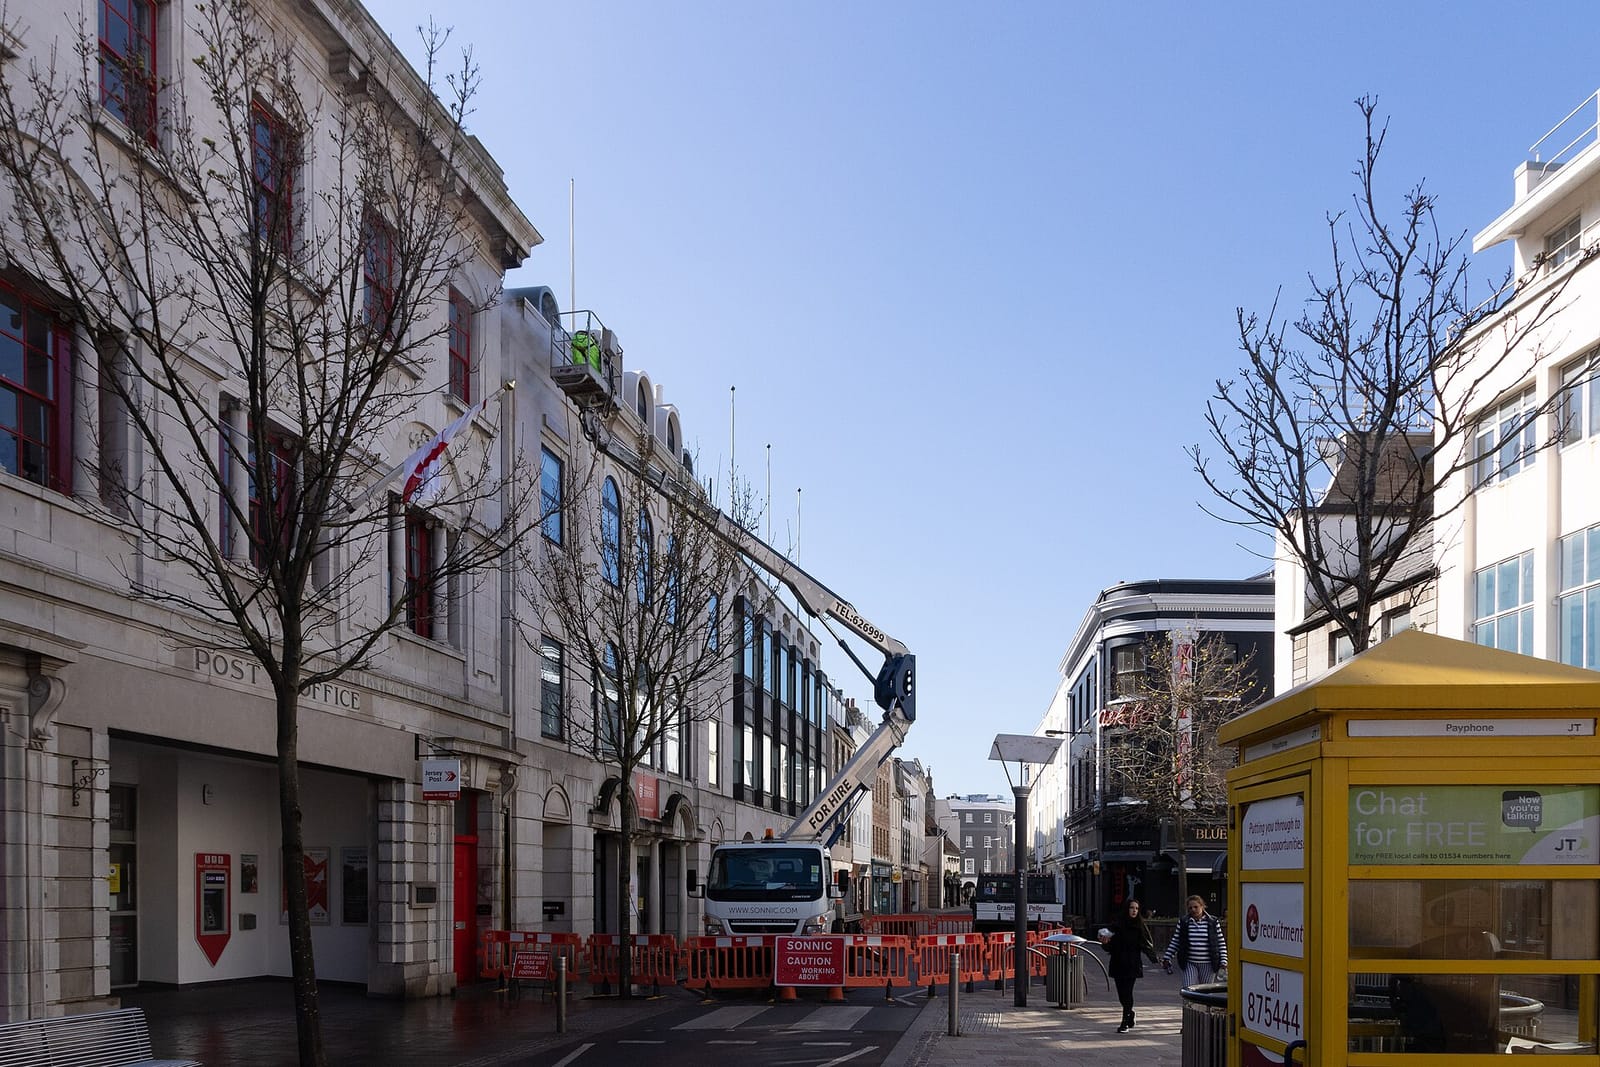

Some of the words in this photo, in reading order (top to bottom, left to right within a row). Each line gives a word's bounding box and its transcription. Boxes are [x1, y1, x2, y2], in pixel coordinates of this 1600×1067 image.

[835, 601, 885, 643] TEL:626999
[194, 647, 261, 685] POST
[1446, 723, 1494, 733] Payphone
[1567, 723, 1582, 732] JT
[808, 803, 831, 829] FOR
[827, 778, 852, 808] HIRE
[1355, 790, 1429, 816] Chat
[1518, 795, 1540, 804] Now
[1509, 804, 1540, 813] you're
[1506, 812, 1540, 822] talking
[1248, 822, 1265, 836] Putting
[1265, 822, 1274, 833] you
[1274, 818, 1294, 833] through
[1294, 818, 1301, 829] to
[1195, 828, 1228, 840] BLUE
[1354, 821, 1397, 847] for
[1406, 821, 1487, 847] FREE
[1245, 840, 1253, 853] the
[1253, 841, 1263, 852] best
[1262, 839, 1270, 854] job
[1554, 839, 1577, 851] JT
[728, 906, 798, 914] WWW.SONNIC.COM
[1259, 920, 1304, 943] recruitment
[786, 940, 833, 951] SONNIC
[787, 956, 832, 966] CAUTION
[798, 973, 819, 981] ABOVE
[801, 967, 836, 975] WORKING
[1264, 970, 1280, 994] Call
[1247, 992, 1301, 1036] 875444
